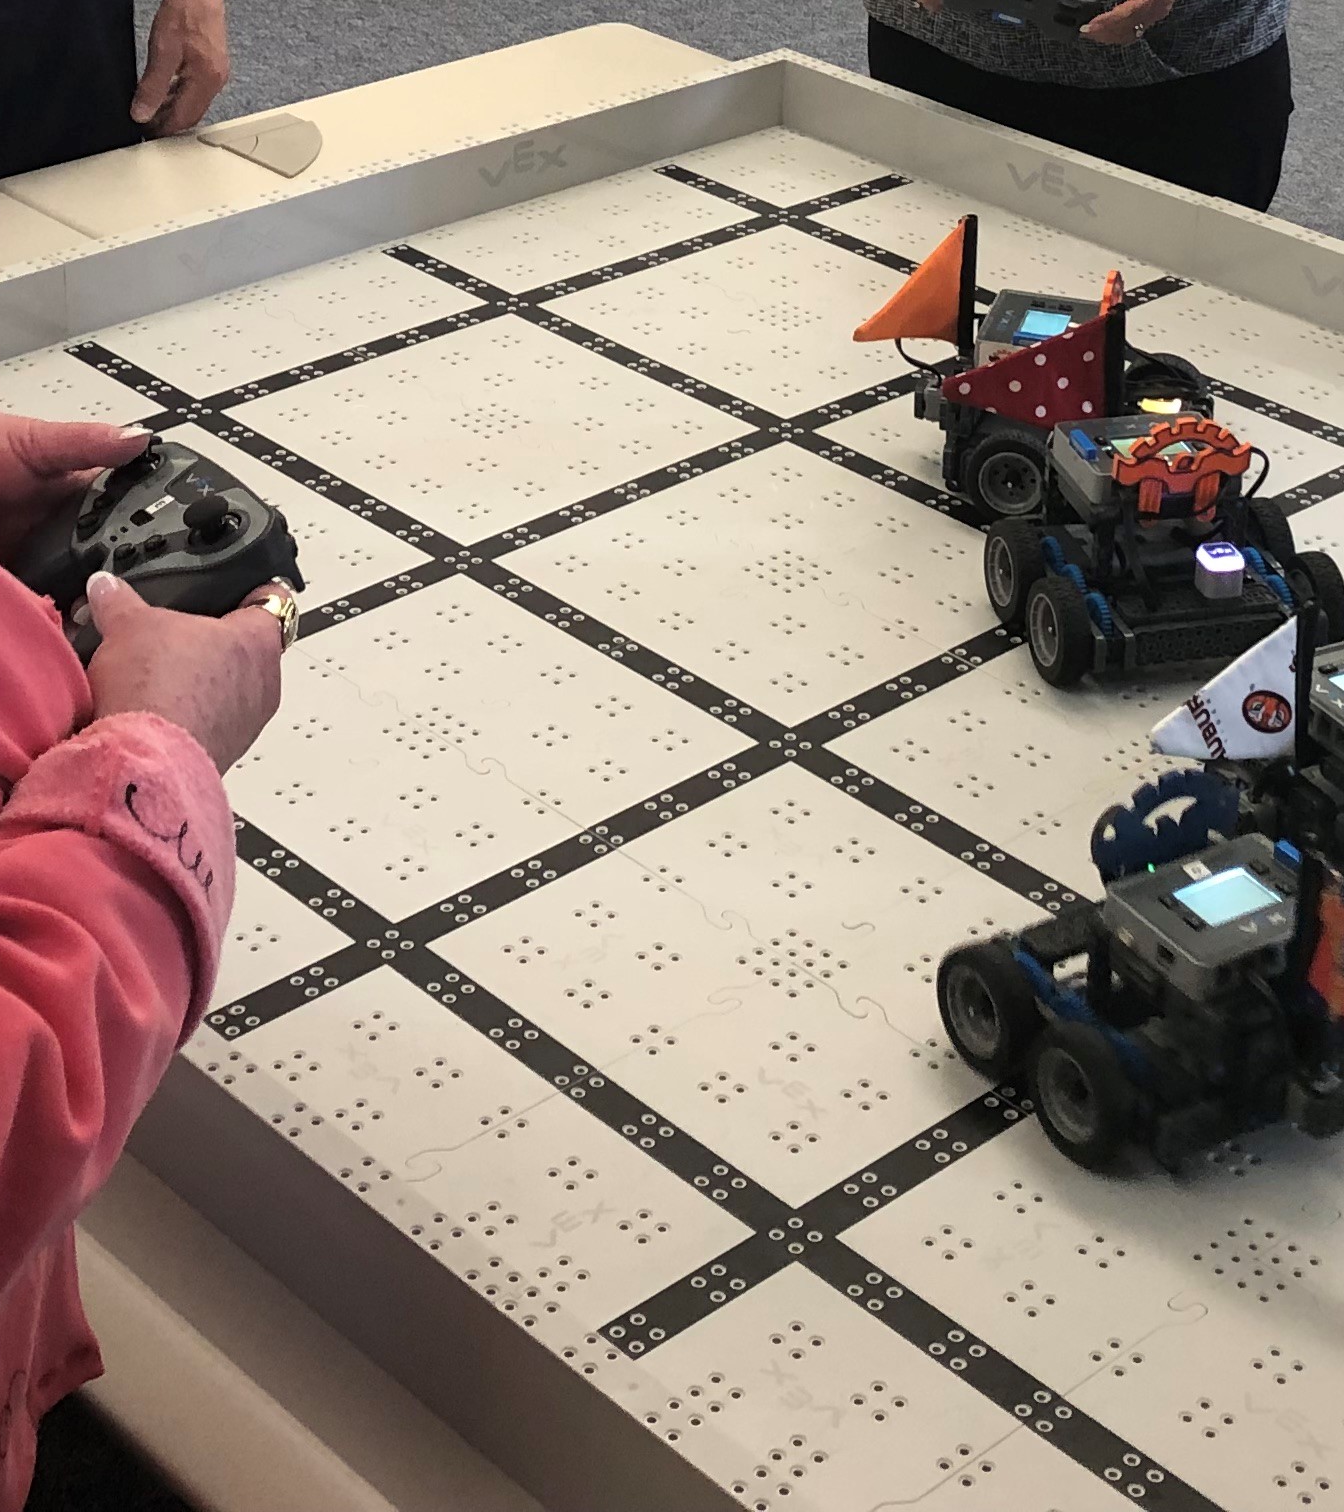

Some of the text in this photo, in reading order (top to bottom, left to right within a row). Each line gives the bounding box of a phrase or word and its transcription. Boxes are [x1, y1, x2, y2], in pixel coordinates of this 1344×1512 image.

[477, 138, 568, 188] VEX
[1005, 160, 1100, 218] VEX
[1185, 694, 1228, 760] UBUR
